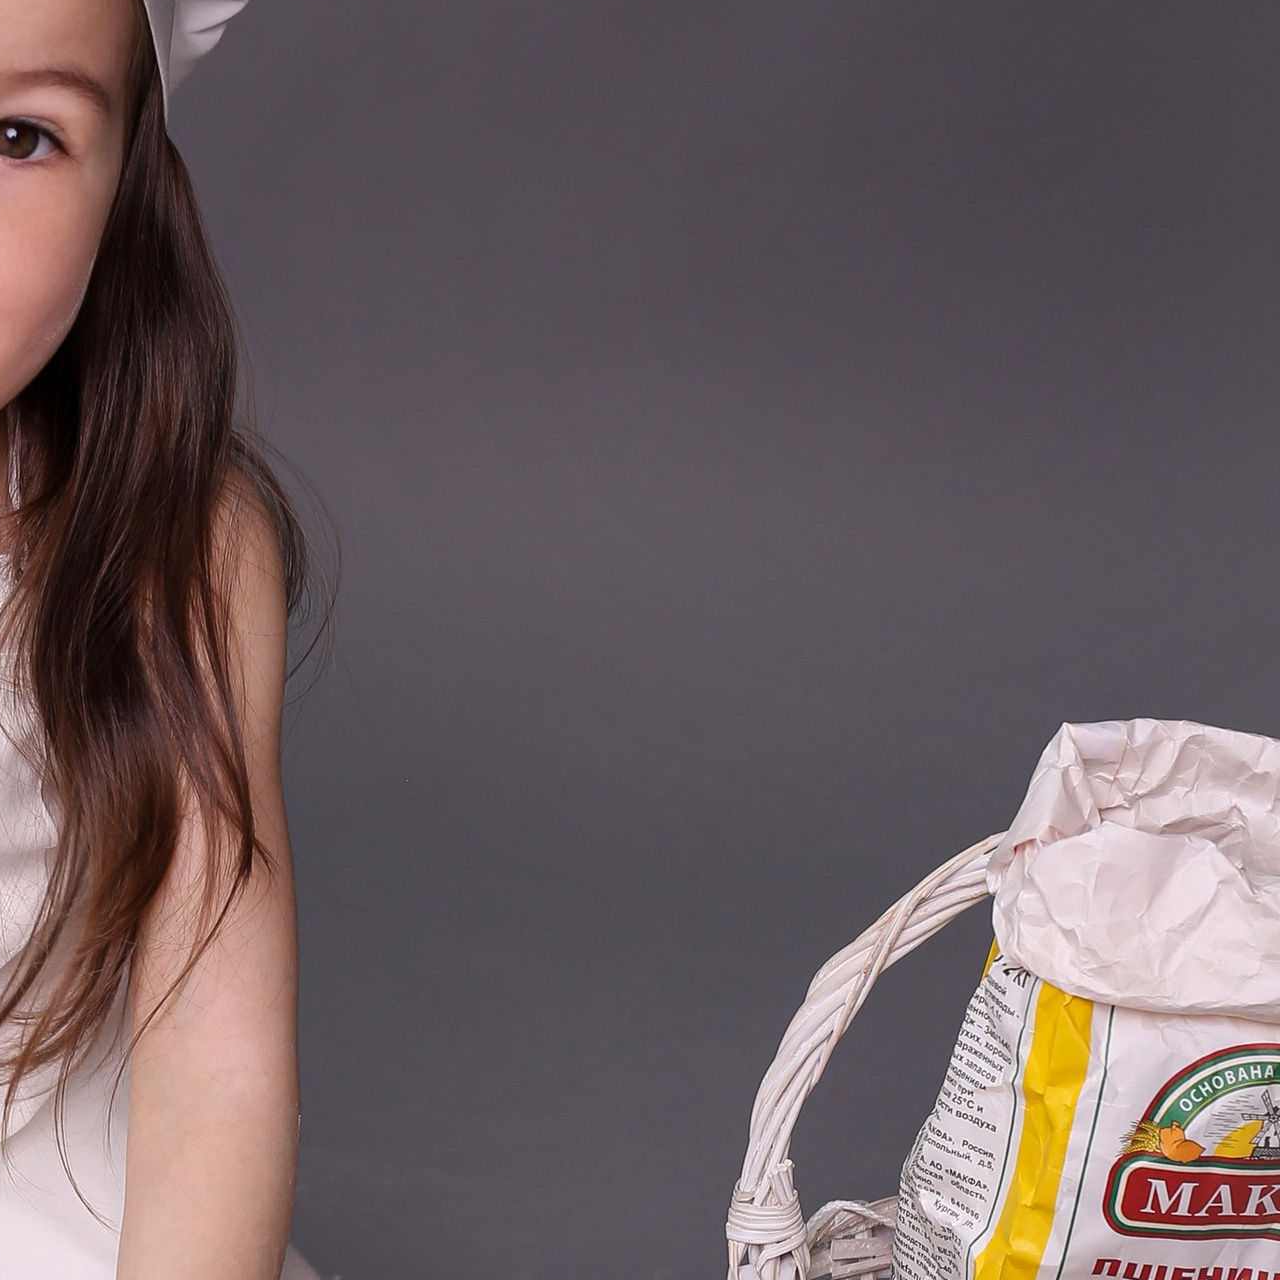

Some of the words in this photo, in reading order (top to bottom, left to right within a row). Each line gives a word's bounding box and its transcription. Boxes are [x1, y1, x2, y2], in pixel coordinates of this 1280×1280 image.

[964, 1058, 997, 1084] запасов
[1179, 1064, 1275, 1113] ОСНОВАНА
[955, 1110, 997, 1133] воздуха
[962, 1139, 996, 1161] Россия,
[950, 1180, 987, 1203] область,
